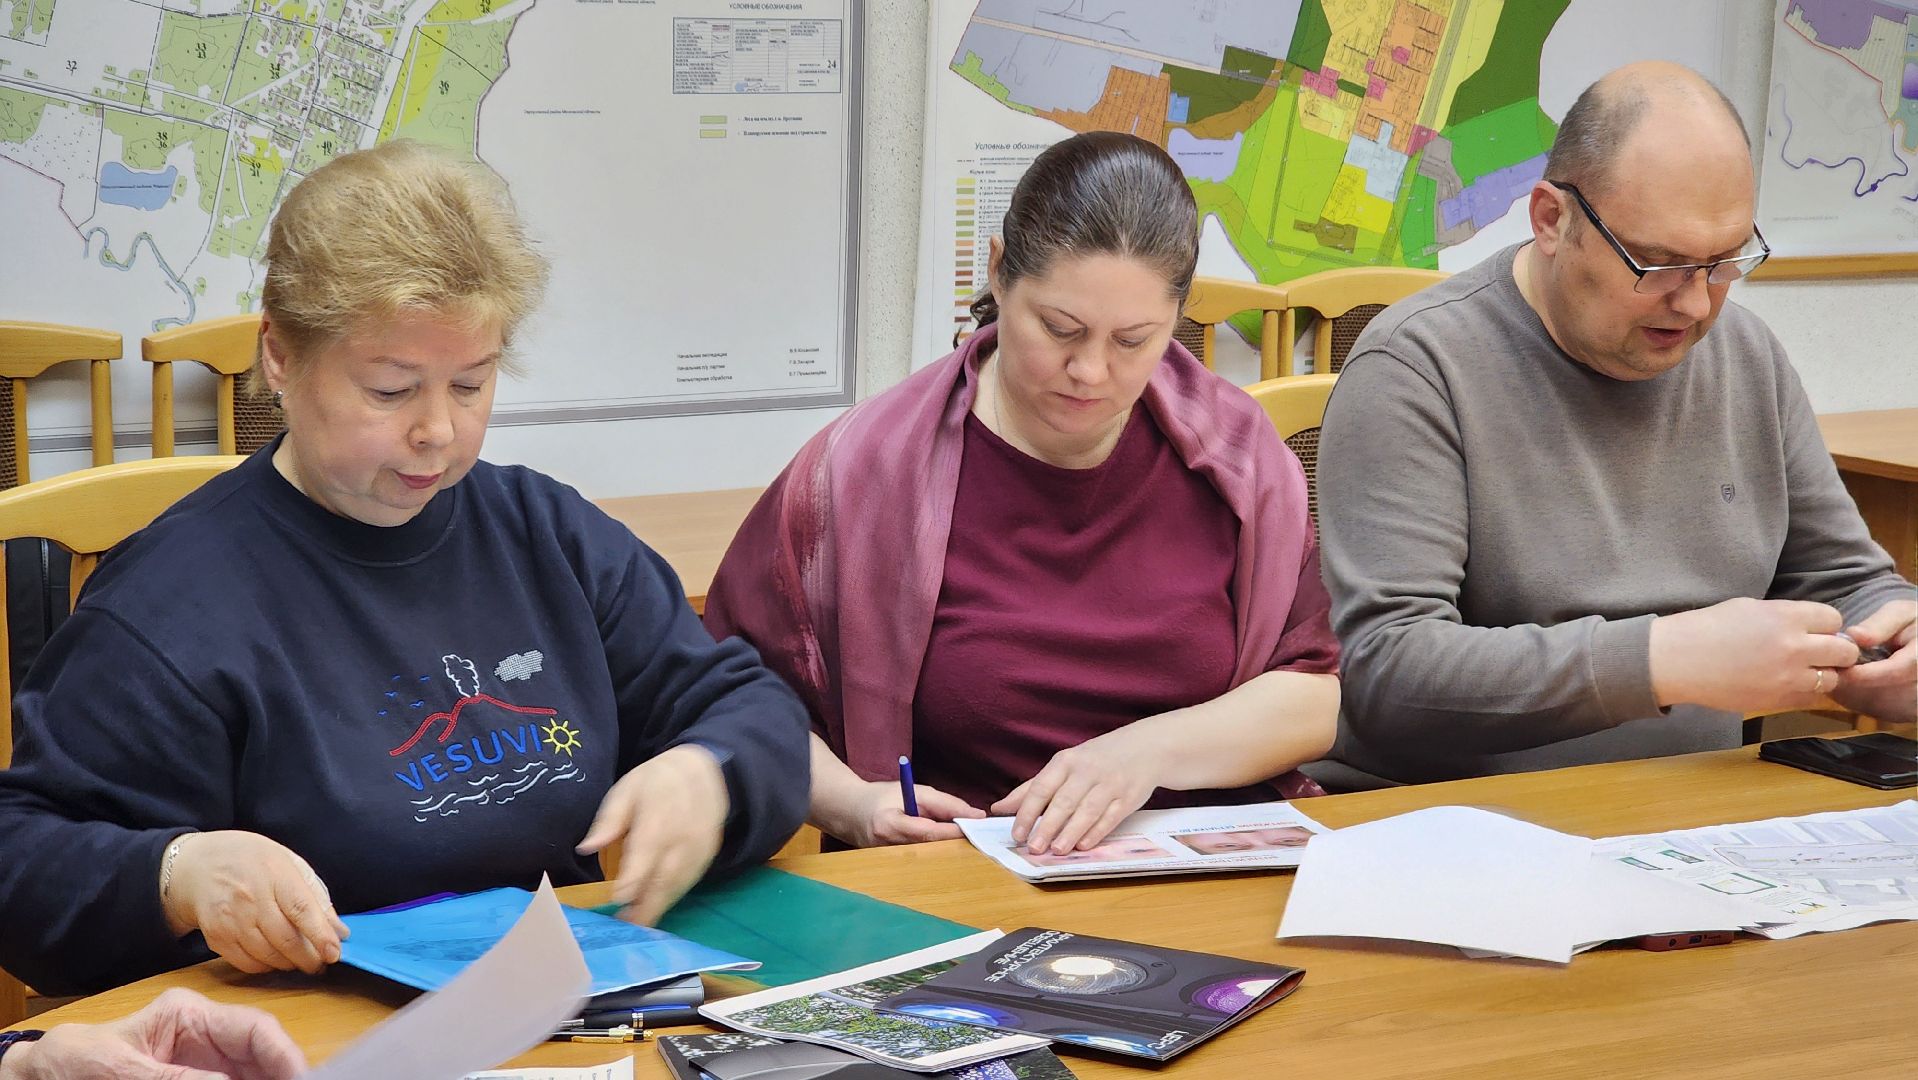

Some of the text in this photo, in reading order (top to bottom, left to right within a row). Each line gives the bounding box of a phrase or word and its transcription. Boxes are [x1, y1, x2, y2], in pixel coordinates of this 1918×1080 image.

[827, 60, 837, 69] 24
[975, 142, 1011, 150] Условные
[984, 933, 1074, 982] АРХИТЕКТУРНОЕ
[993, 930, 1061, 965] ОСВЕЩЕНИЕ
